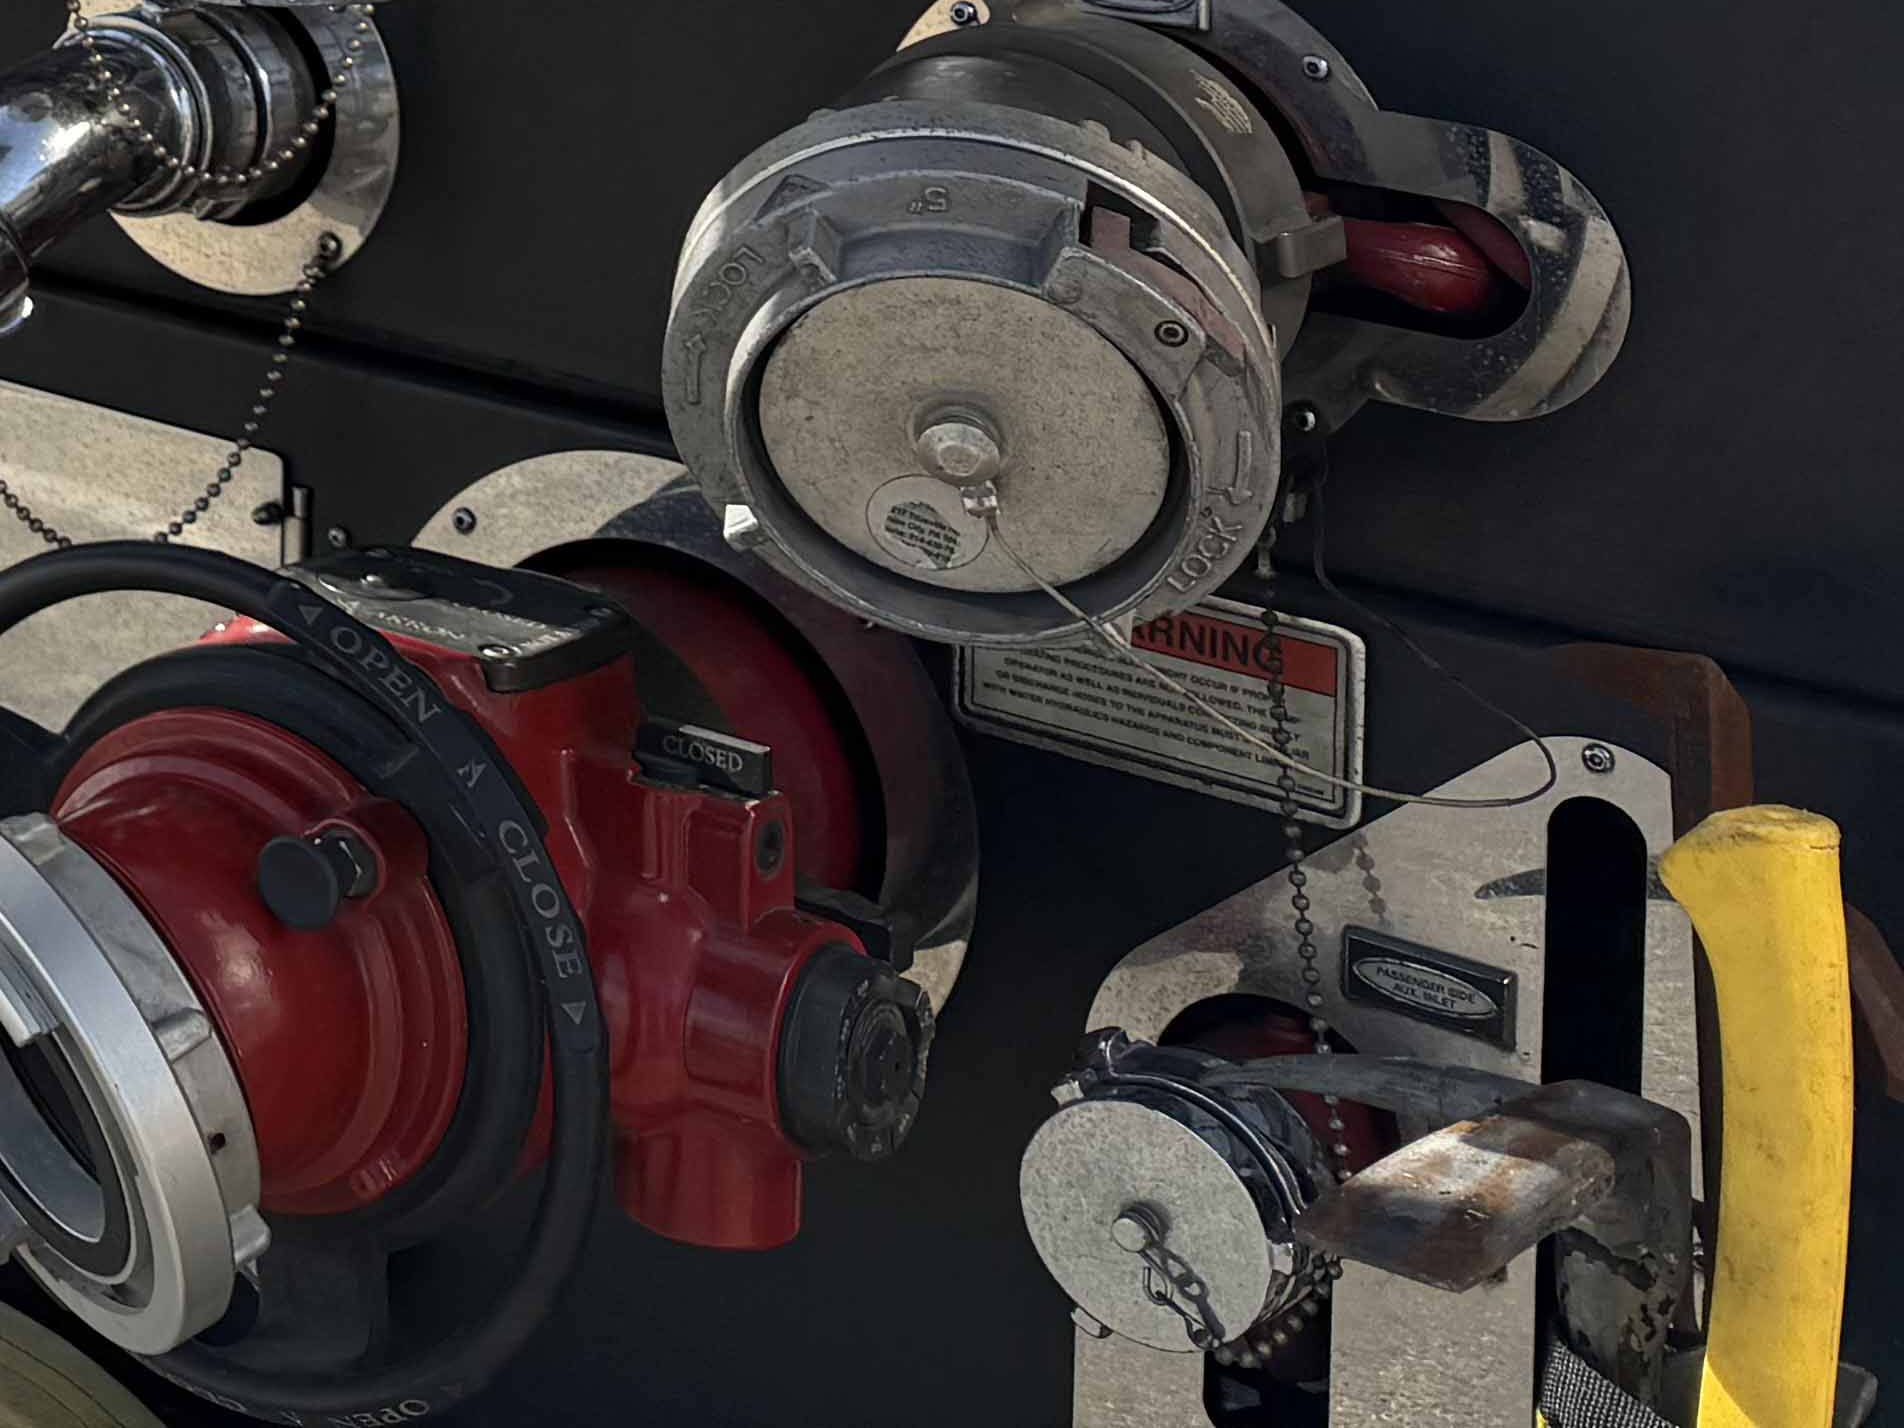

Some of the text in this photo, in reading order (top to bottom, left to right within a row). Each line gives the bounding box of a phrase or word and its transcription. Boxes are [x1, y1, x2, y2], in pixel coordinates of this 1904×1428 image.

[1166, 514, 1244, 593] LOCK
[329, 625, 442, 726] OPEN
[1132, 615, 1283, 675] ARNING
[663, 735, 744, 774] CLOSED
[497, 818, 584, 980] CLOSE
[1377, 966, 1445, 993] PASSENGER
